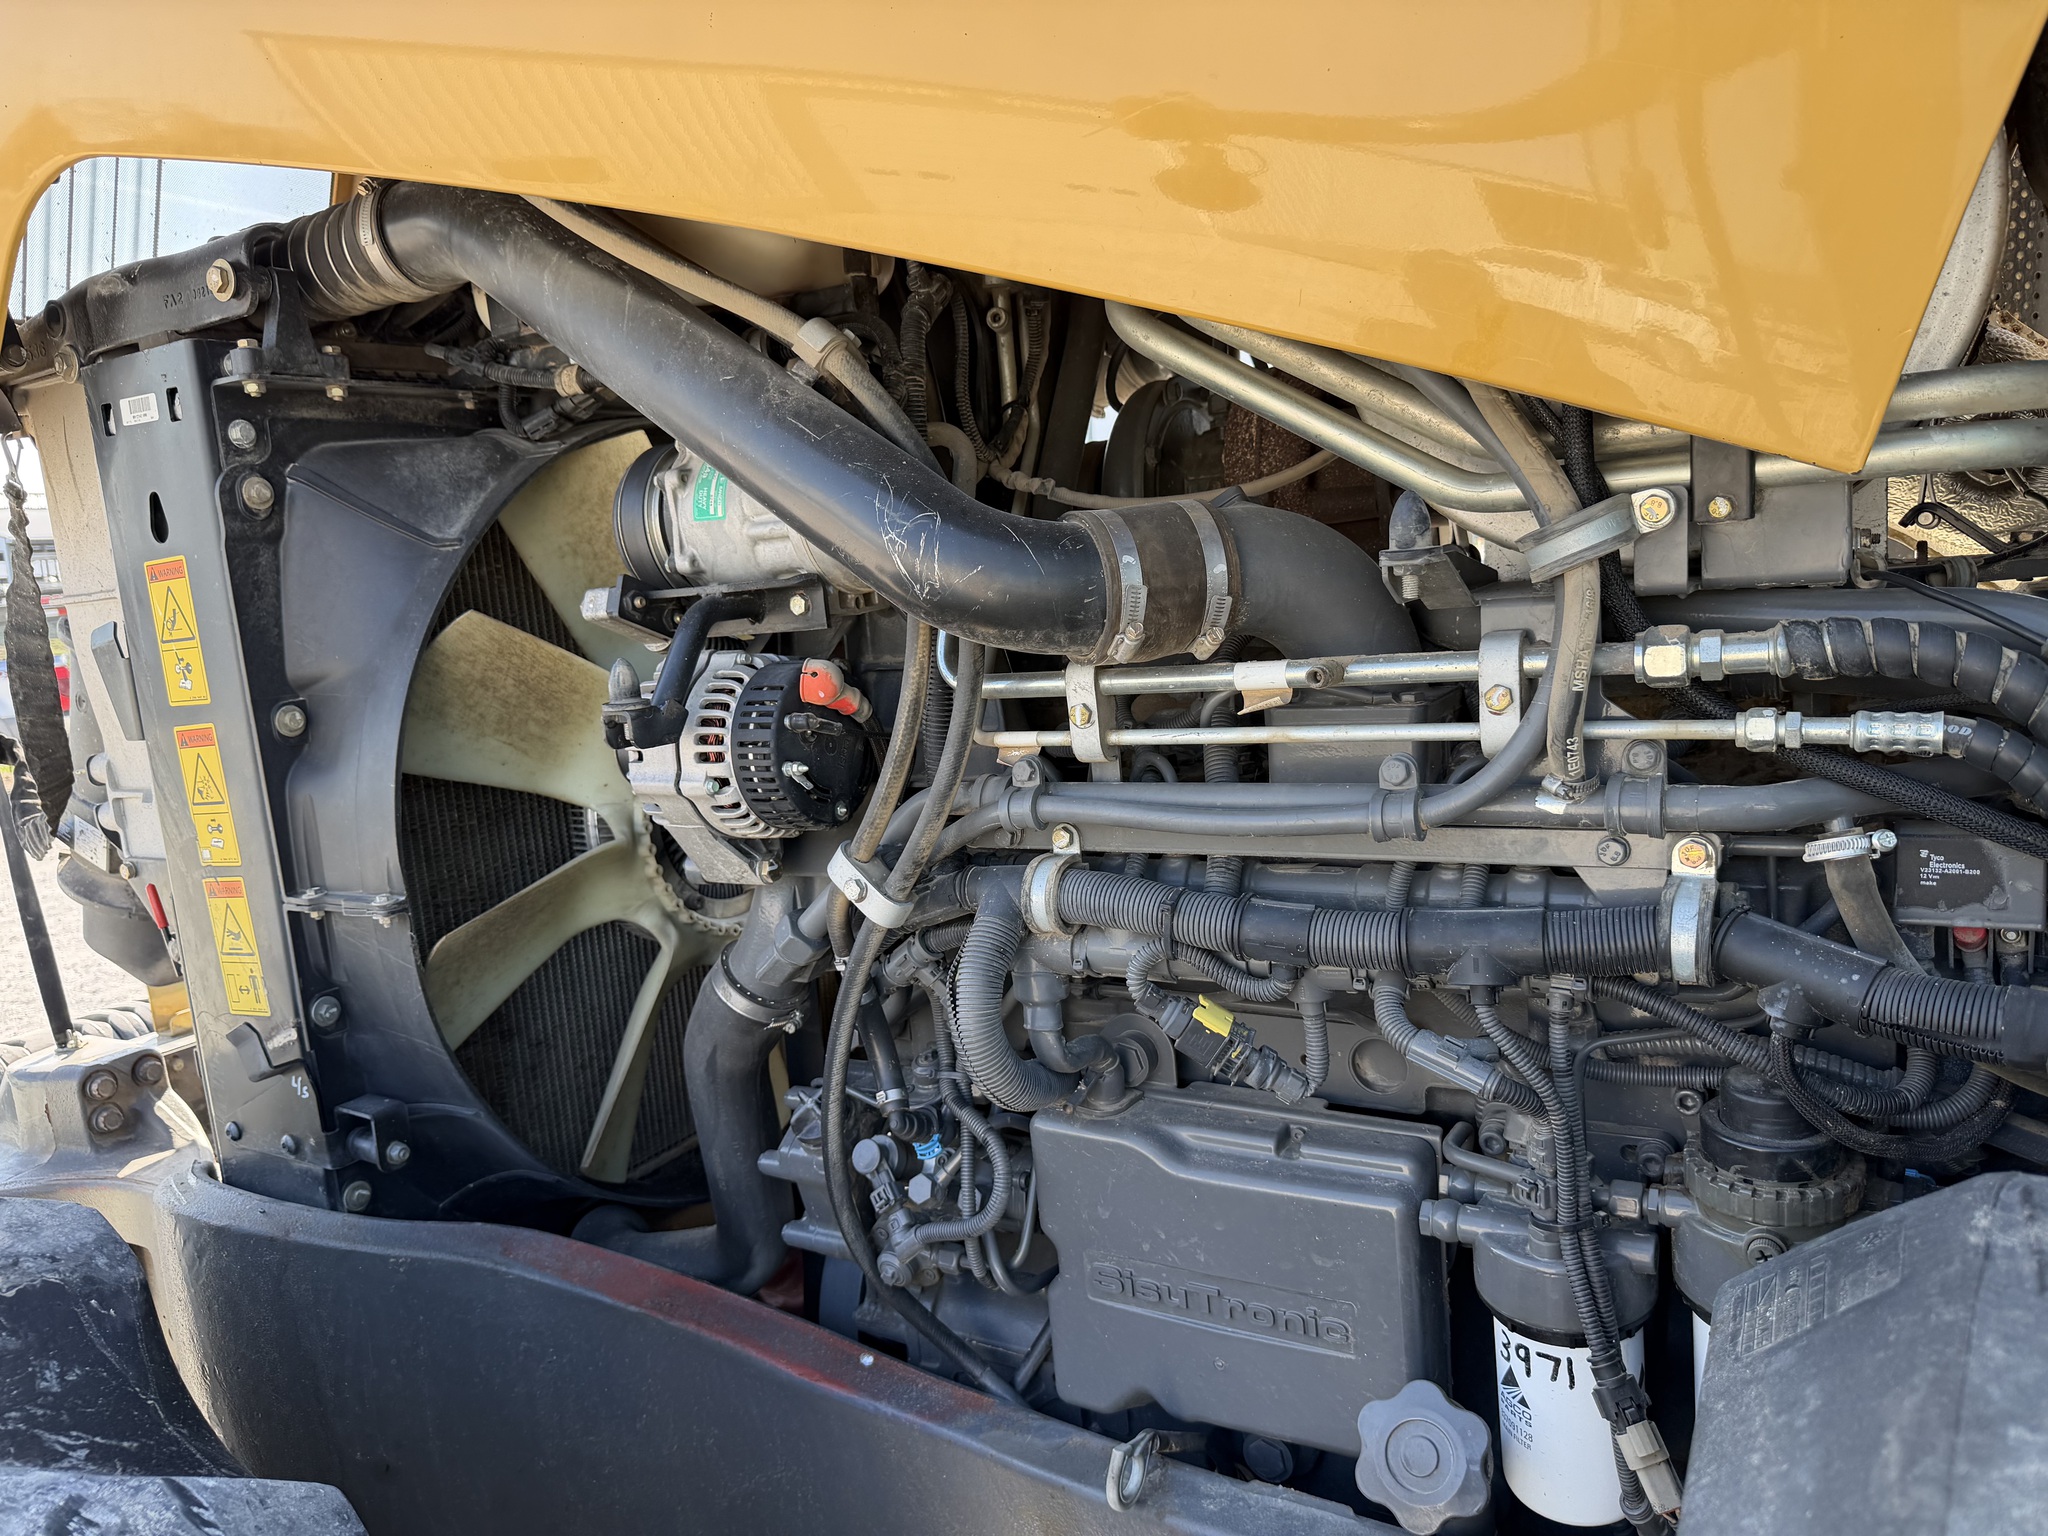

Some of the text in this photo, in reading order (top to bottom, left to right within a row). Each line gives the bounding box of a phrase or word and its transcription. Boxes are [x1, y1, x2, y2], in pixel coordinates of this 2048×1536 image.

[158, 565, 183, 577] WARNING
[187, 733, 213, 743] WARNING
[1566, 736, 1579, 777] 1E0743
[1929, 861, 1966, 869] Electronics
[1930, 854, 1945, 862] Tyco
[1092, 1262, 1352, 1343] SisuTronic
[1500, 1329, 1576, 1390] 3971
[1500, 1390, 1532, 1421] AGCO
[1500, 1396, 1533, 1428] PARTS
[1513, 1433, 1532, 1451] FILTER
